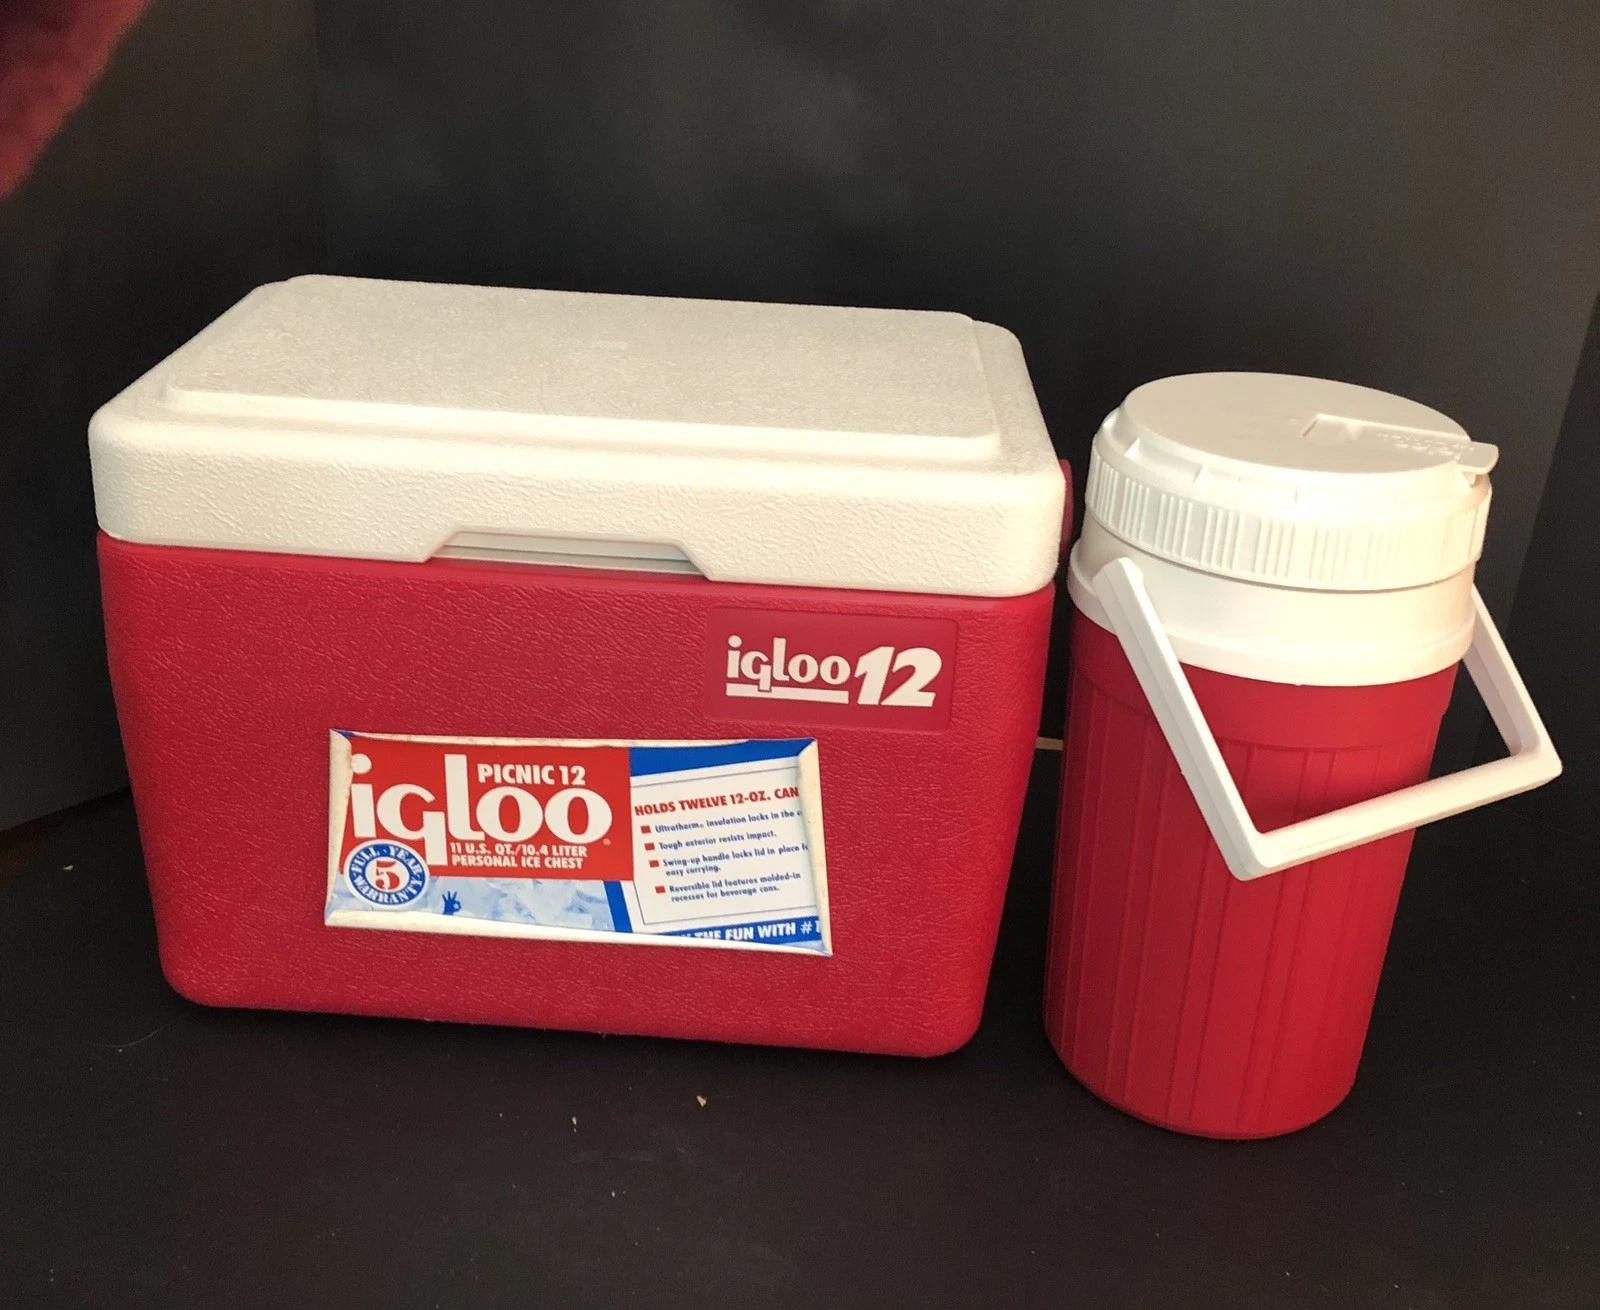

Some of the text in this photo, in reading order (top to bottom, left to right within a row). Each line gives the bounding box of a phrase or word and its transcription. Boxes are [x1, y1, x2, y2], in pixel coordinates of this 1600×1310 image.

[726, 635, 942, 707] igloo 12
[477, 763, 586, 785] PICNIC 12
[350, 753, 613, 866] igloo
[634, 802, 676, 816] HOLDS
[678, 795, 728, 811] TWELVE
[730, 790, 771, 805] 12-OZ.
[706, 813, 746, 827] insulation
[748, 812, 769, 822] locks
[771, 811, 779, 819] in
[781, 809, 794, 818] the
[450, 842, 462, 854] 11
[465, 843, 491, 855] U.S.
[552, 845, 587, 857] LITER
[659, 830, 776, 850] Tough exterior resists impact.
[351, 845, 422, 876] FULL YEAR
[452, 855, 583, 869] PERSONAL ICE CHEST
[663, 857, 700, 867] Swing-up
[702, 852, 730, 862] handle
[732, 849, 753, 860] locks
[754, 847, 766, 857] lid
[767, 847, 775, 855] in
[778, 844, 800, 855] place
[375, 860, 400, 890] 5
[665, 864, 721, 877] easy carrying.
[354, 875, 422, 904] WARRANTY
[669, 872, 801, 893] Reversible lid features molded-in
[671, 884, 780, 902] recesses for beverage cans.
[725, 926, 754, 941] FUN
[757, 922, 796, 939] WITH
